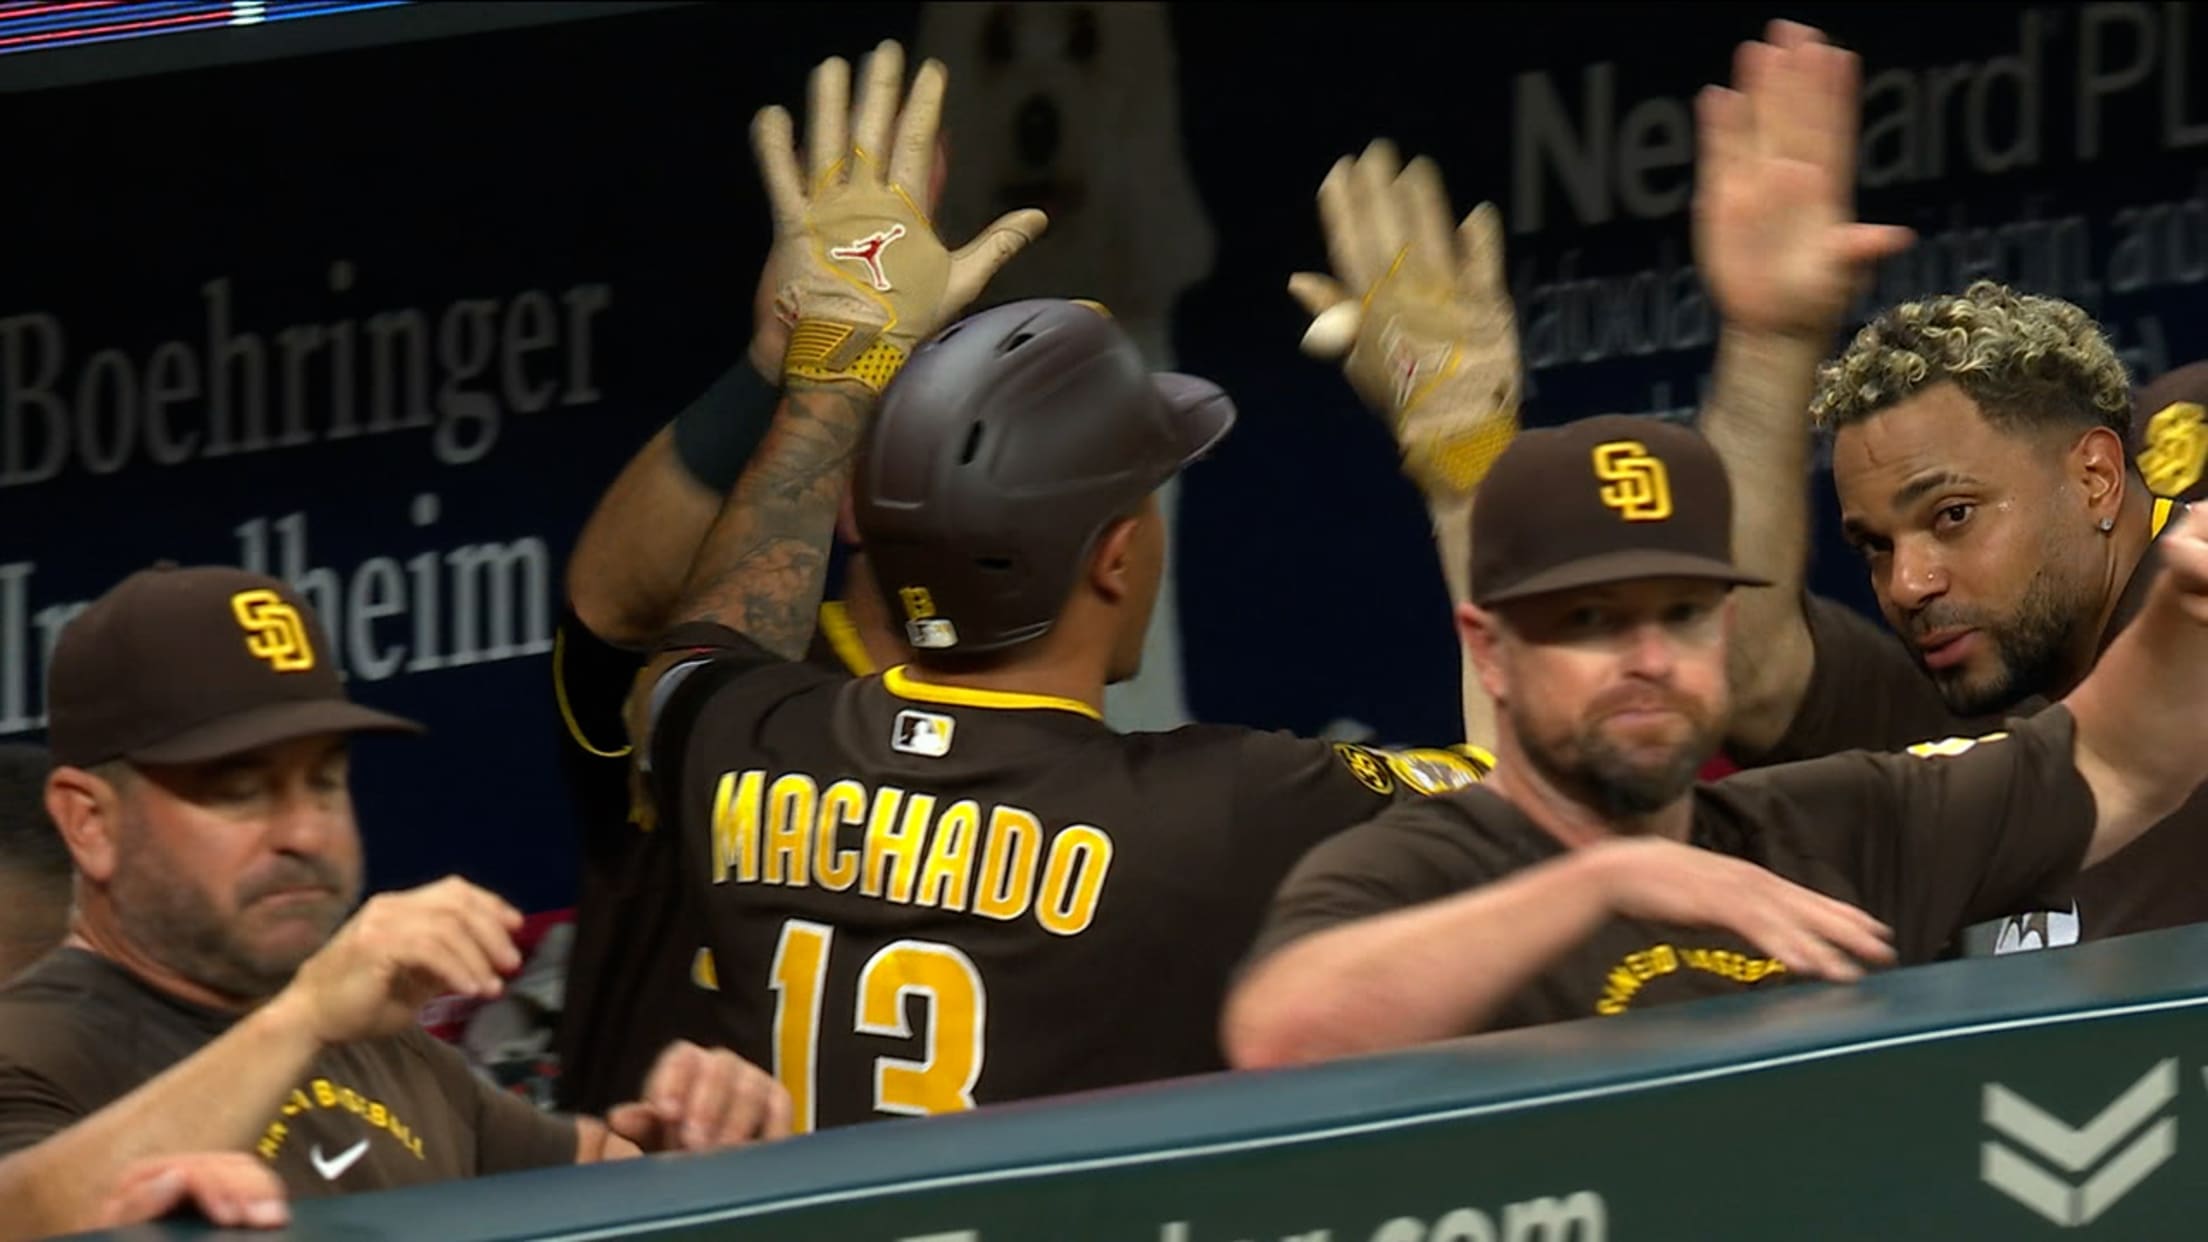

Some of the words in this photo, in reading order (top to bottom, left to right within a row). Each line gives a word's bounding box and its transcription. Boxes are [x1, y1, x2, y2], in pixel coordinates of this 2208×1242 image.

[1512, 6, 2042, 236] Neard
[0, 258, 613, 488] Boehringer
[711, 769, 1113, 937] MACHADO
[767, 916, 987, 1136] 13
